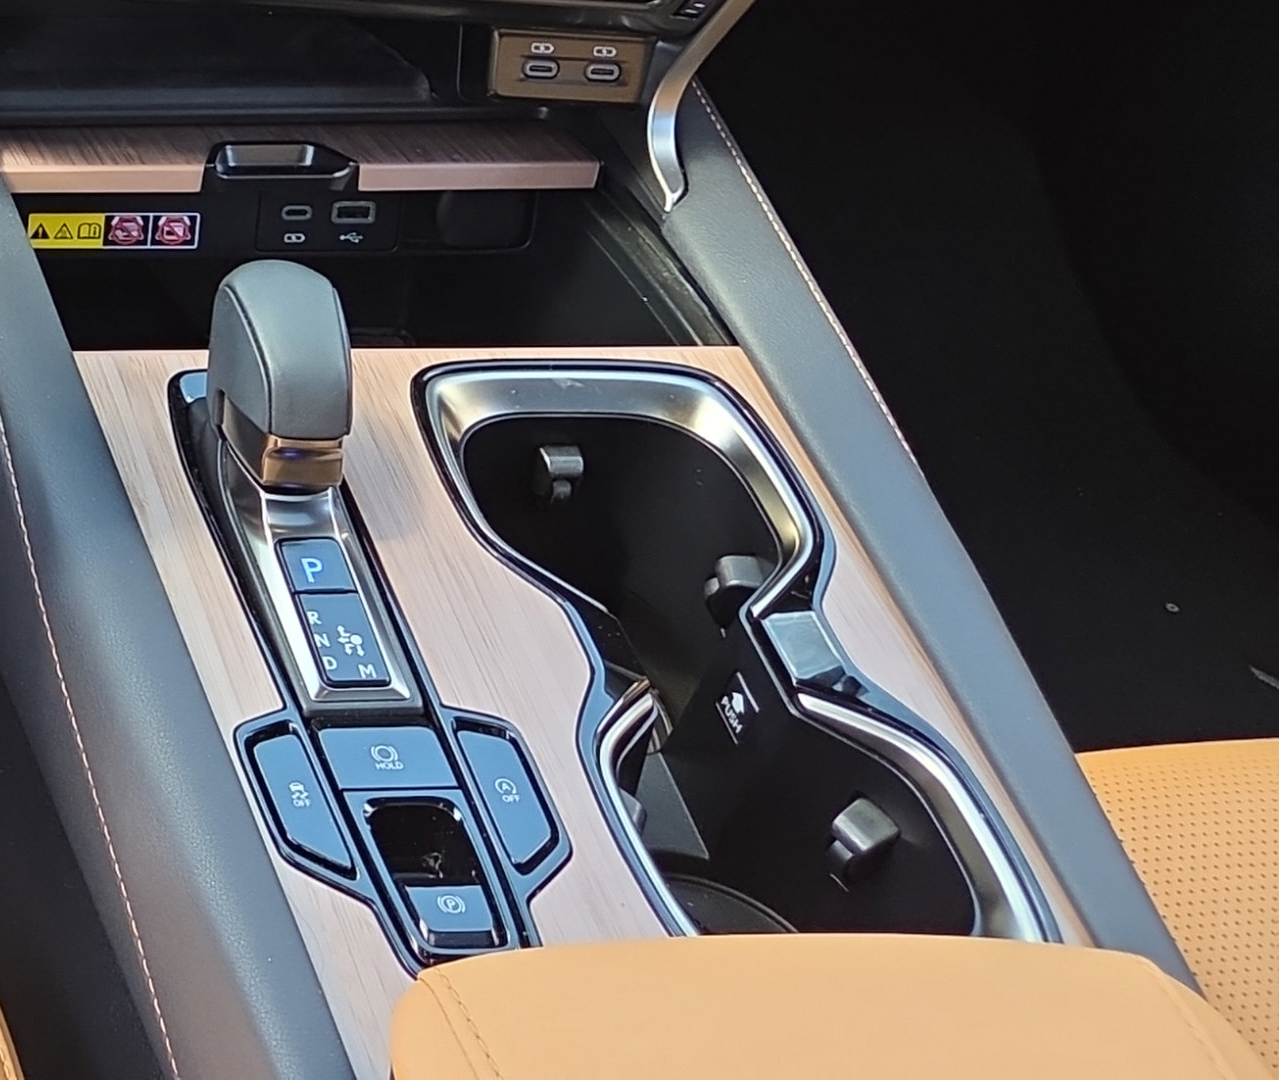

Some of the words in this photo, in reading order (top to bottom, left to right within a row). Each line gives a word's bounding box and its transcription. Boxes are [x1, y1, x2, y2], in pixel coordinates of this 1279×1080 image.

[301, 558, 322, 583] P
[306, 611, 322, 625] R
[313, 633, 331, 648] N
[322, 656, 338, 670] D
[358, 663, 377, 678] M
[721, 695, 743, 734] PUSH
[375, 762, 404, 770] HOLD
[293, 799, 311, 808] OFF
[502, 795, 520, 803] OFF
